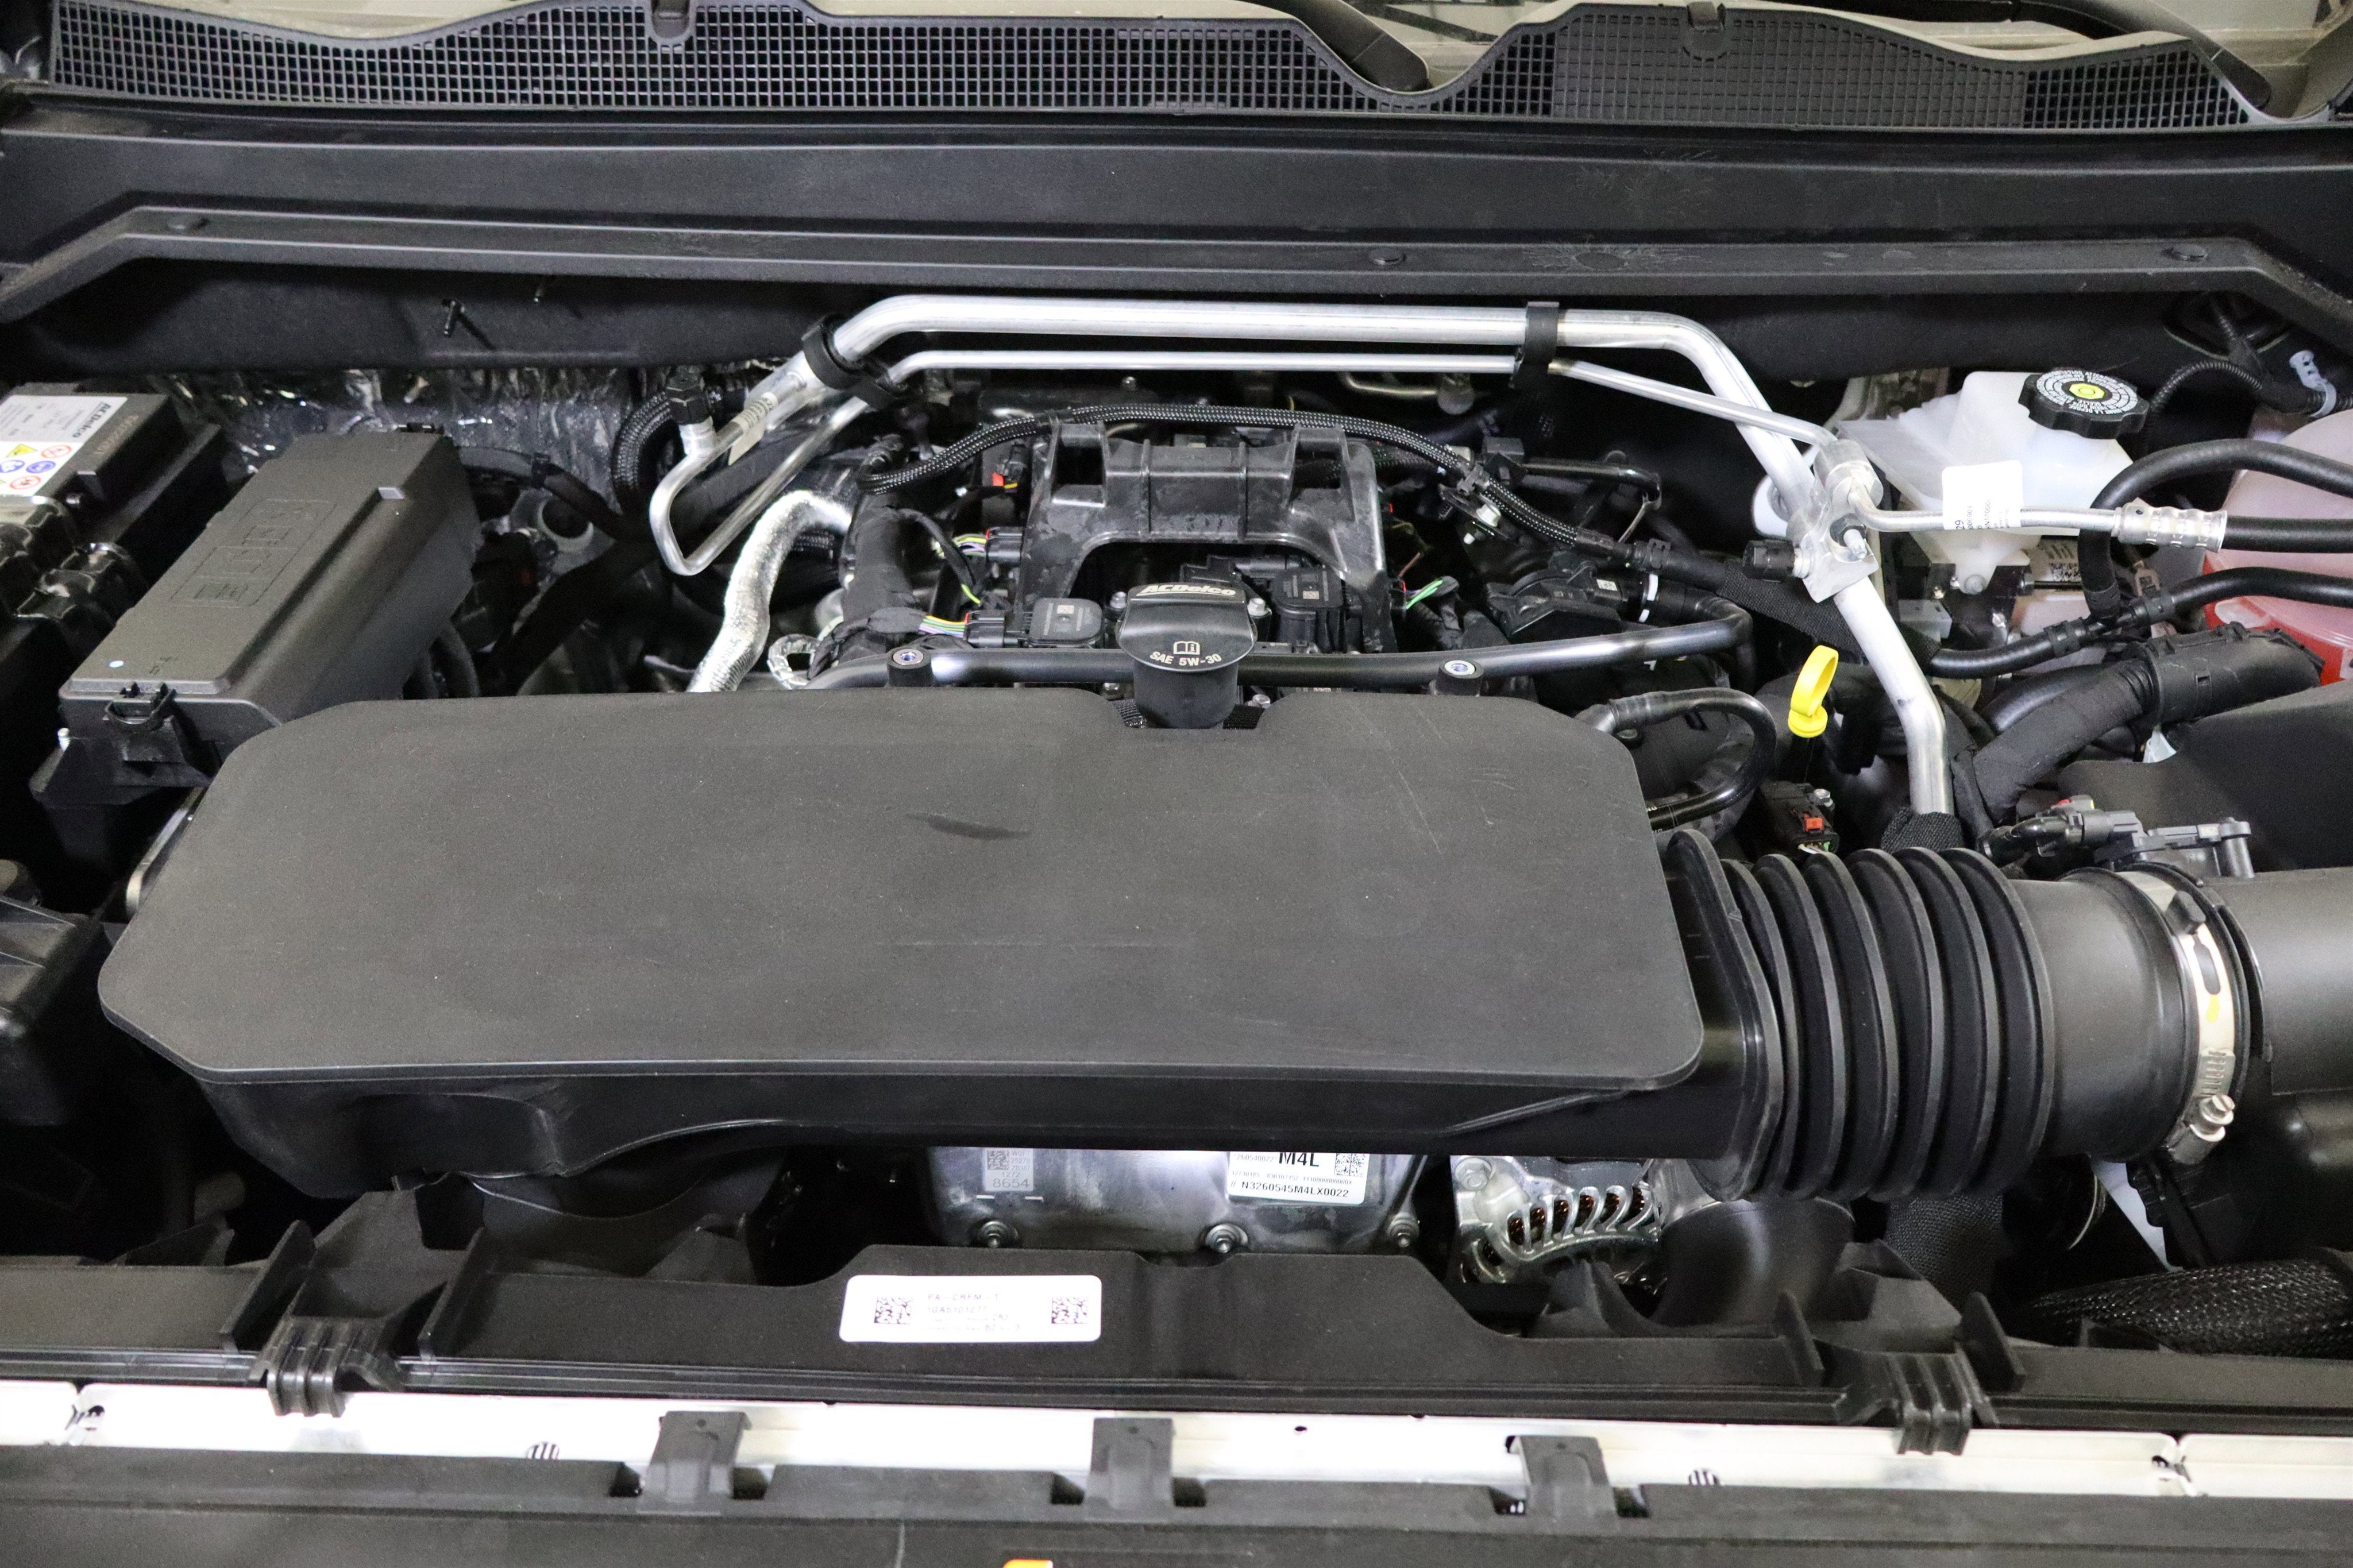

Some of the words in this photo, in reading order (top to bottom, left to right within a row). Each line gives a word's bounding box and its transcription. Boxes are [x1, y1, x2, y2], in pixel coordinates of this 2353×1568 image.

[72, 403, 111, 438] ACDelco
[1140, 584, 1236, 596] ACDelco
[1150, 651, 1174, 665] SAE
[1179, 653, 1222, 666] 5W-30
[1279, 1152, 1320, 1167] M4L
[993, 1178, 1029, 1188] 8654
[1241, 1181, 1349, 1198] N3260545M4LX0022
